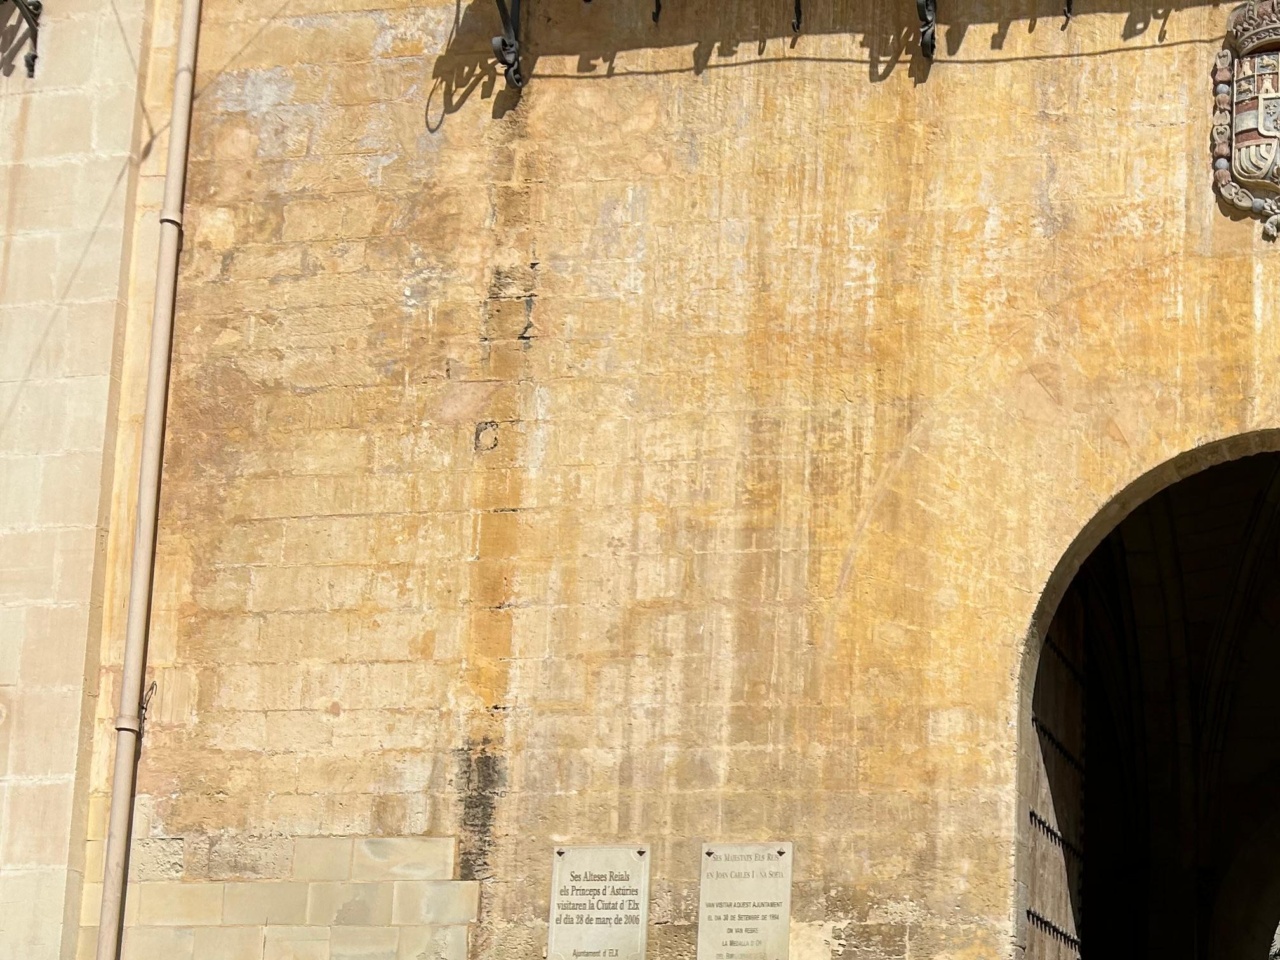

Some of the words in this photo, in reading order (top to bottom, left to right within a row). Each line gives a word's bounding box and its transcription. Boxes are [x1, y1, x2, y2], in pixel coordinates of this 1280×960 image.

[569, 871, 581, 882] Ses
[583, 871, 607, 882] Alteses
[609, 871, 630, 882] Reials
[559, 885, 569, 896] els
[570, 885, 601, 899] Prínceps
[556, 900, 587, 911] visitaren
[588, 900, 595, 911] la
[596, 900, 618, 911] Ciutat
[555, 914, 562, 925] el
[575, 914, 584, 925] 28
[585, 914, 594, 925] de
[595, 916, 612, 928] març
[614, 914, 623, 925] de
[623, 914, 640, 925] 2006
[572, 949, 601, 959] Ajuntament
